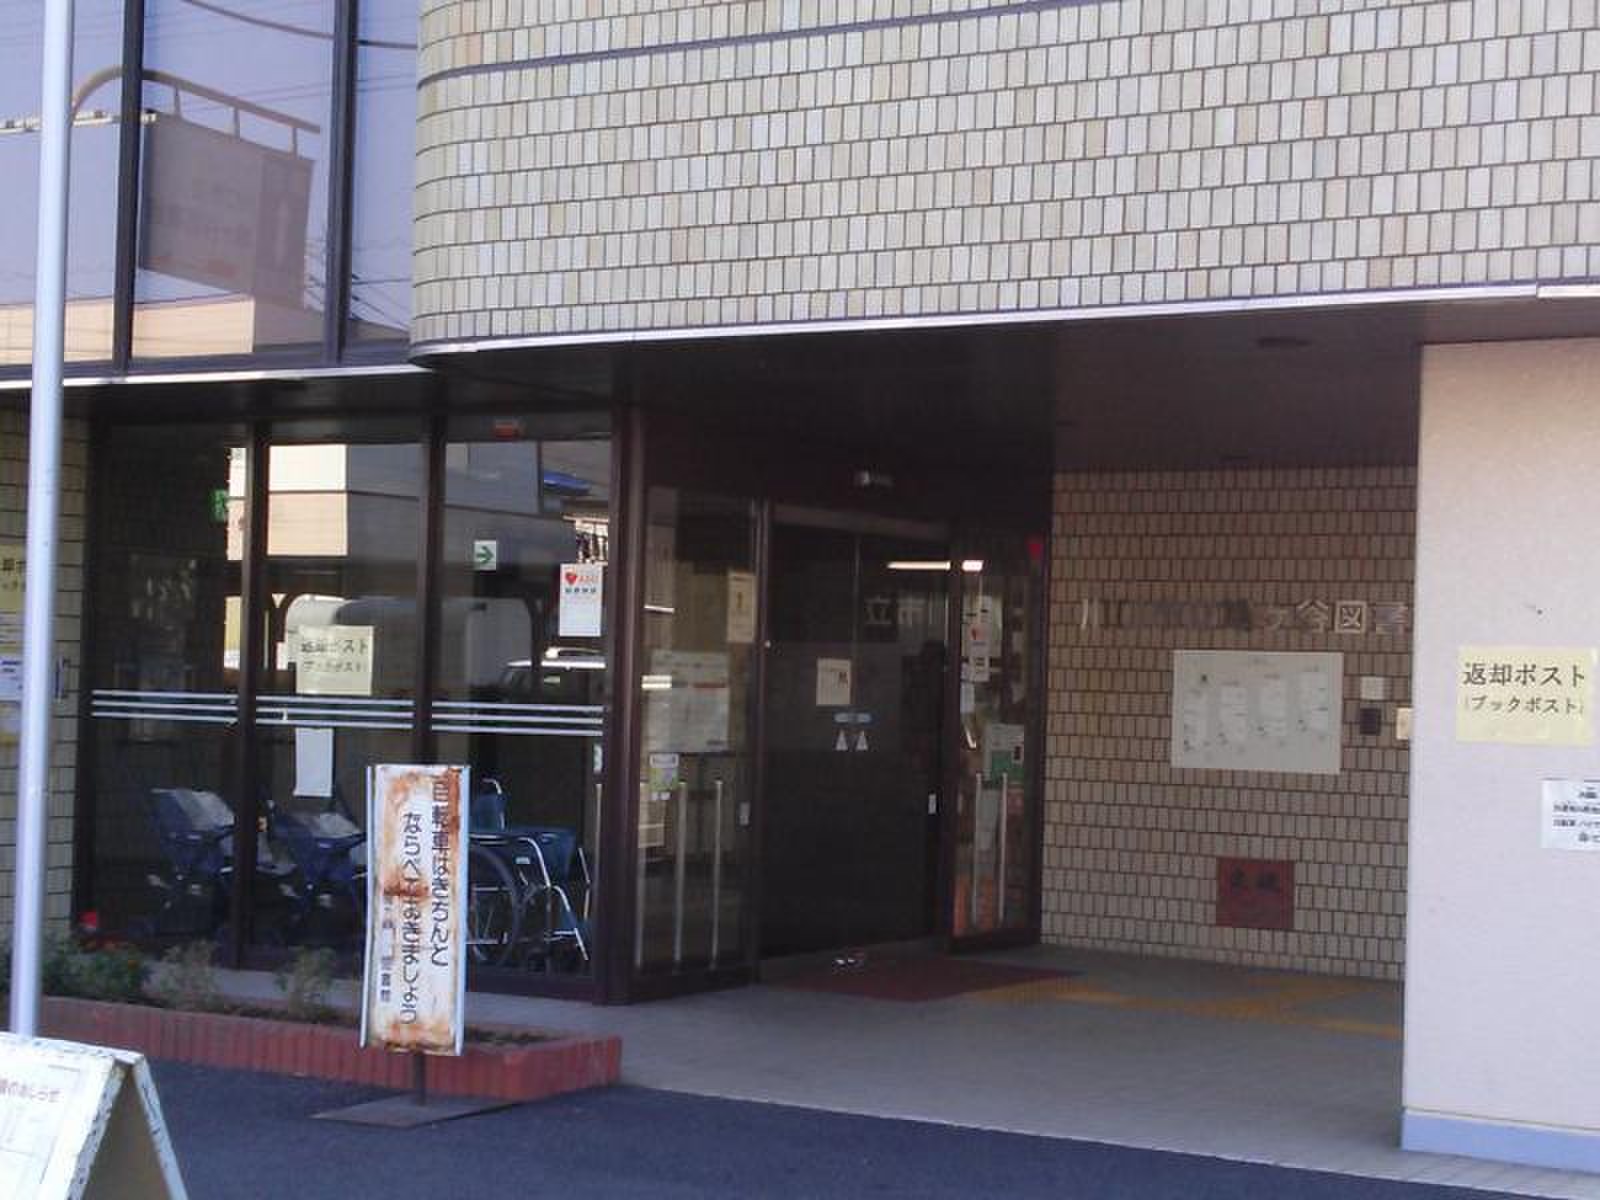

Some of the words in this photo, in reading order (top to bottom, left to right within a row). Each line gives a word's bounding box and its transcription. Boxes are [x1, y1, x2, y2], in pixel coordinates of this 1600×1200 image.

[1462, 661, 1586, 688] 返却ポスト
